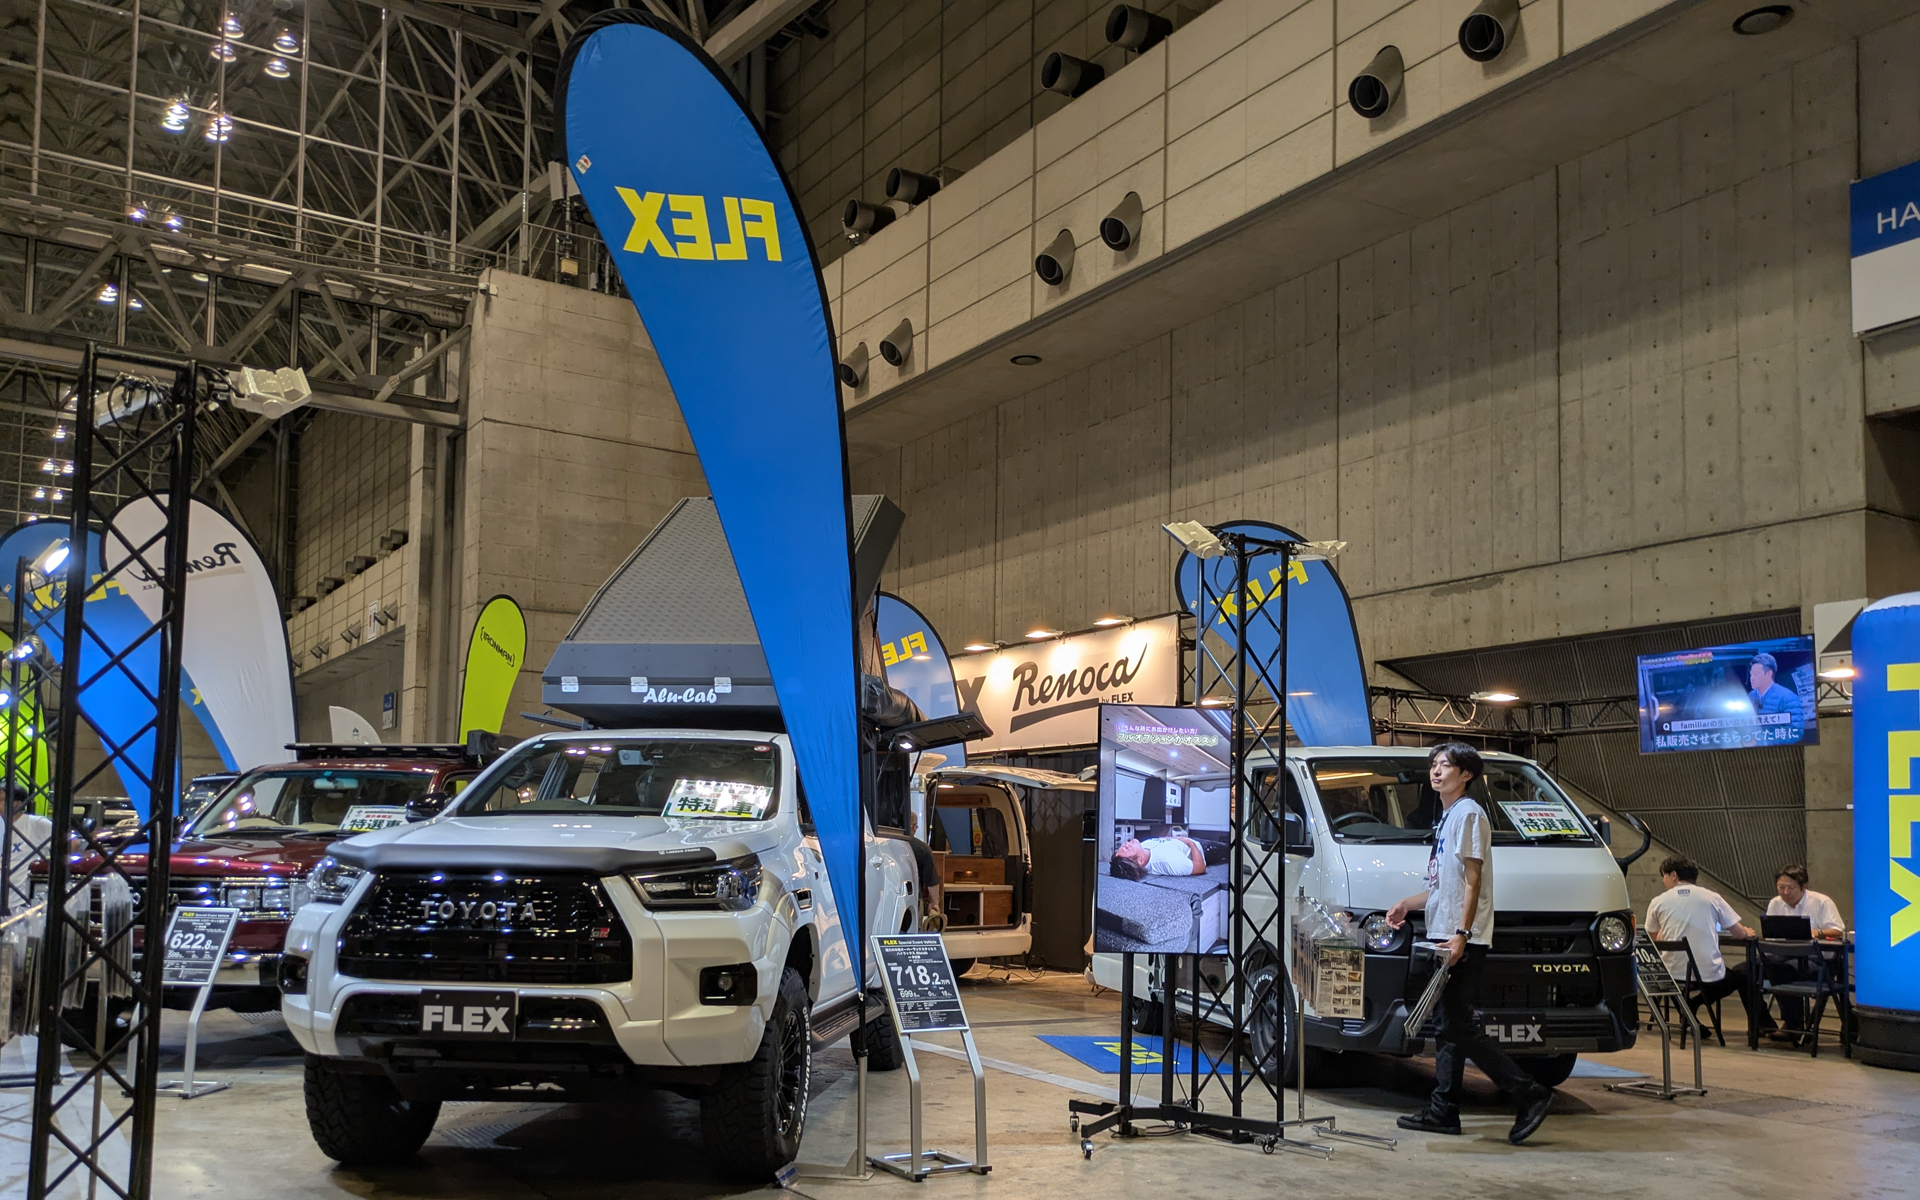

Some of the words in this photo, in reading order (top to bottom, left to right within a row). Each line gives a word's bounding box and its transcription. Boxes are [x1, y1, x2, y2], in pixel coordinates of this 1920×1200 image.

[1012, 642, 1148, 711] Renoca
[643, 687, 717, 704] Alu-Cab
[1111, 692, 1134, 703] FLEX
[1655, 727, 1799, 747] 私販売させてもらってた時に
[1519, 818, 1578, 832] 特選車
[420, 901, 537, 921] TOYOTA
[1532, 964, 1590, 973] TOYOTA
[423, 1005, 510, 1033] FLEX
[802, 1006, 811, 1041] OPEN
[1485, 1024, 1543, 1043] FLEX
